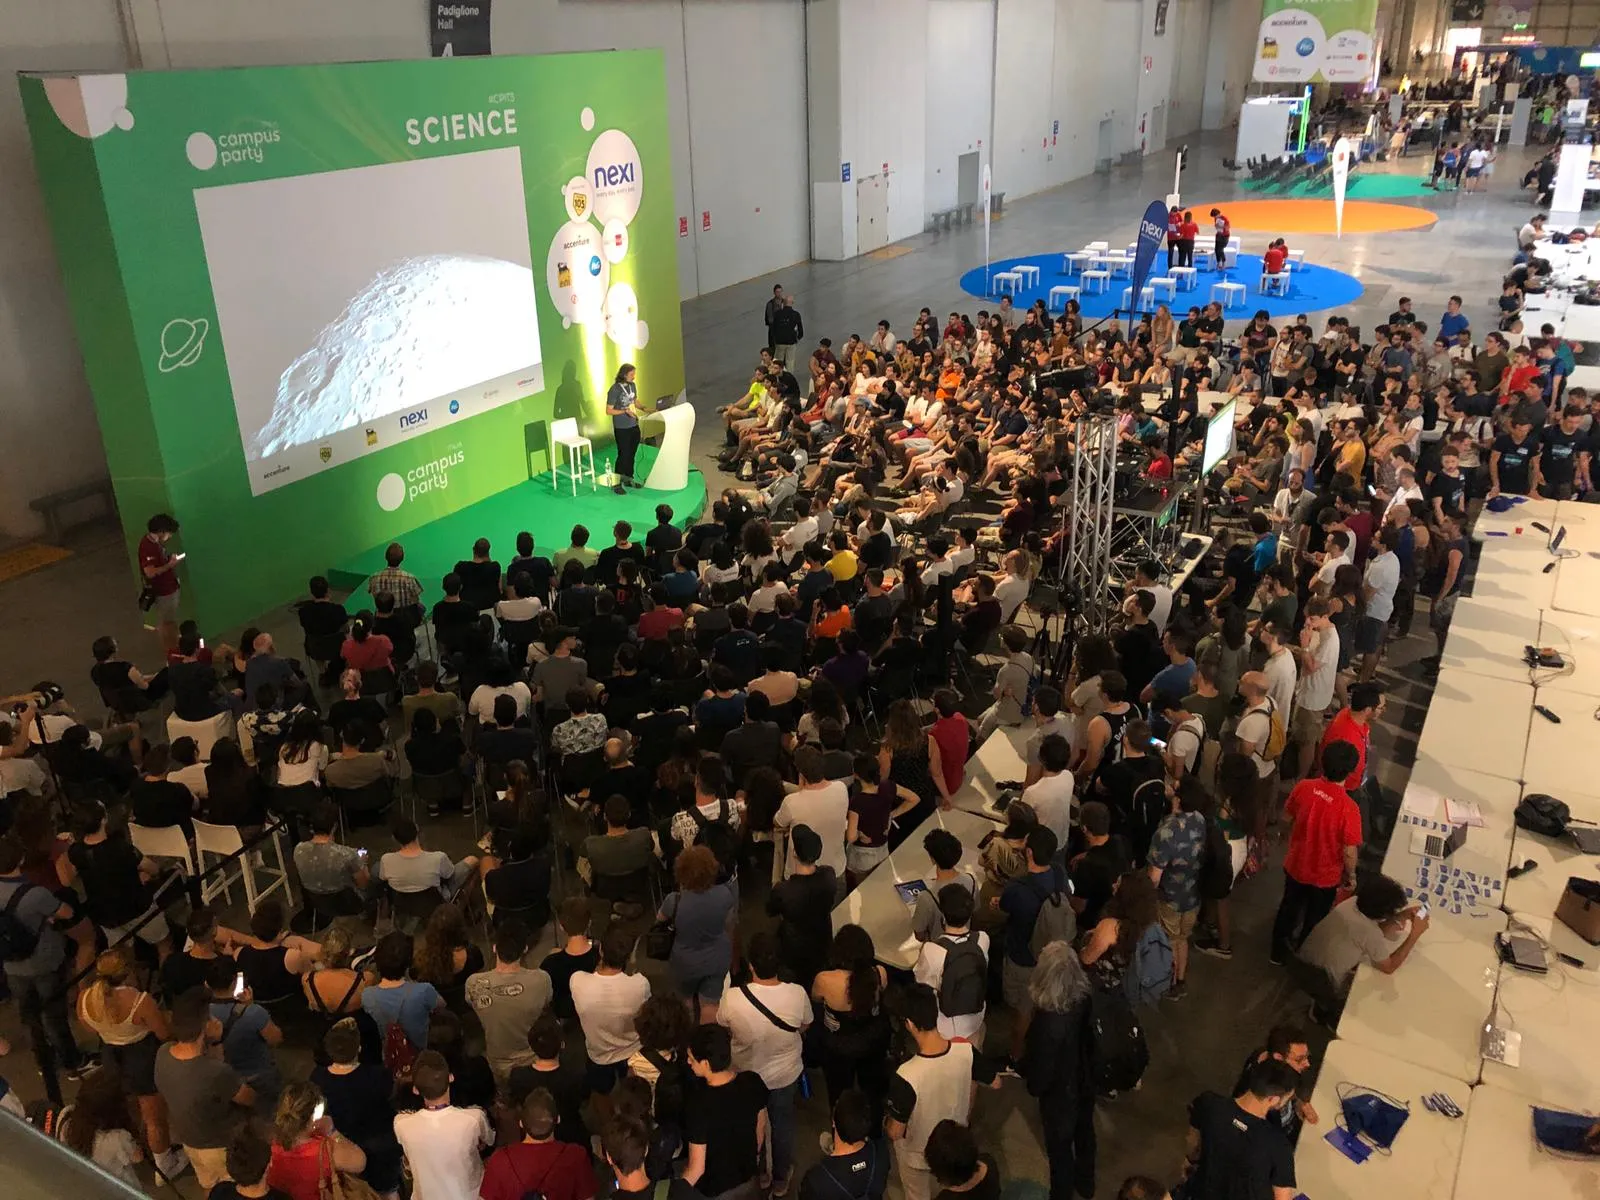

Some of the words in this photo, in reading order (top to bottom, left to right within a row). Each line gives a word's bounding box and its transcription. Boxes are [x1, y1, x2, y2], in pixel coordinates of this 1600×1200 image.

[437, 5, 479, 18] Padiglione
[437, 18, 454, 30] Hall
[405, 108, 518, 146] SCIENCE
[218, 130, 281, 148] campus
[220, 145, 264, 168] party
[594, 162, 635, 189] nexi
[1141, 220, 1163, 240] nexi
[563, 238, 590, 249] accenture
[399, 408, 429, 429] nexi
[407, 450, 465, 482] campus
[409, 472, 448, 502] party
